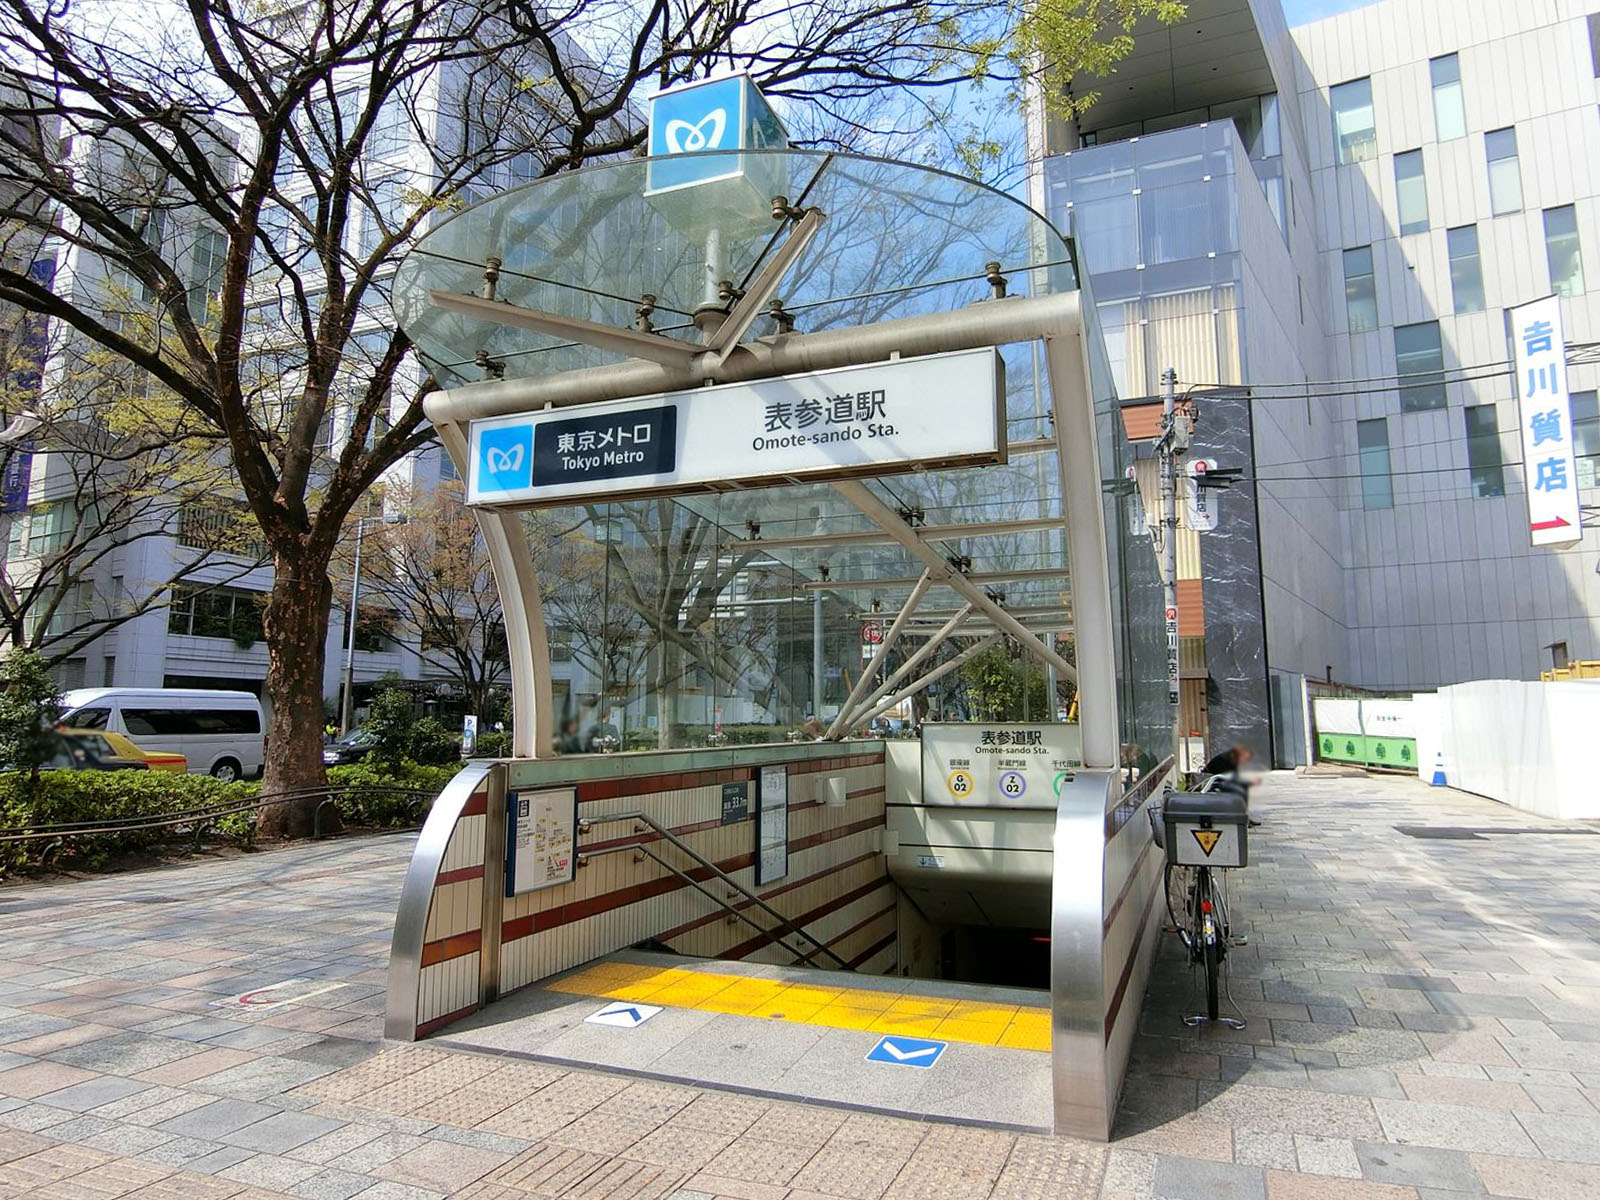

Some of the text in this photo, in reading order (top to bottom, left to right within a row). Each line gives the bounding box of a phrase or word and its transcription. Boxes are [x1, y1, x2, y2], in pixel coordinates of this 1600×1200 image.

[763, 389, 887, 433] 表参道駅
[556, 424, 652, 452] 東京メトロ
[752, 422, 900, 452] Omote-sando Sta.
[561, 448, 645, 471] Tokyo Metro
[981, 730, 1043, 746] 表参道駅
[975, 746, 1050, 754] Omote-sando Sta.
[956, 774, 964, 782] G
[1009, 775, 1016, 783] Z
[954, 783, 967, 792] 02
[1006, 784, 1019, 793] 02
